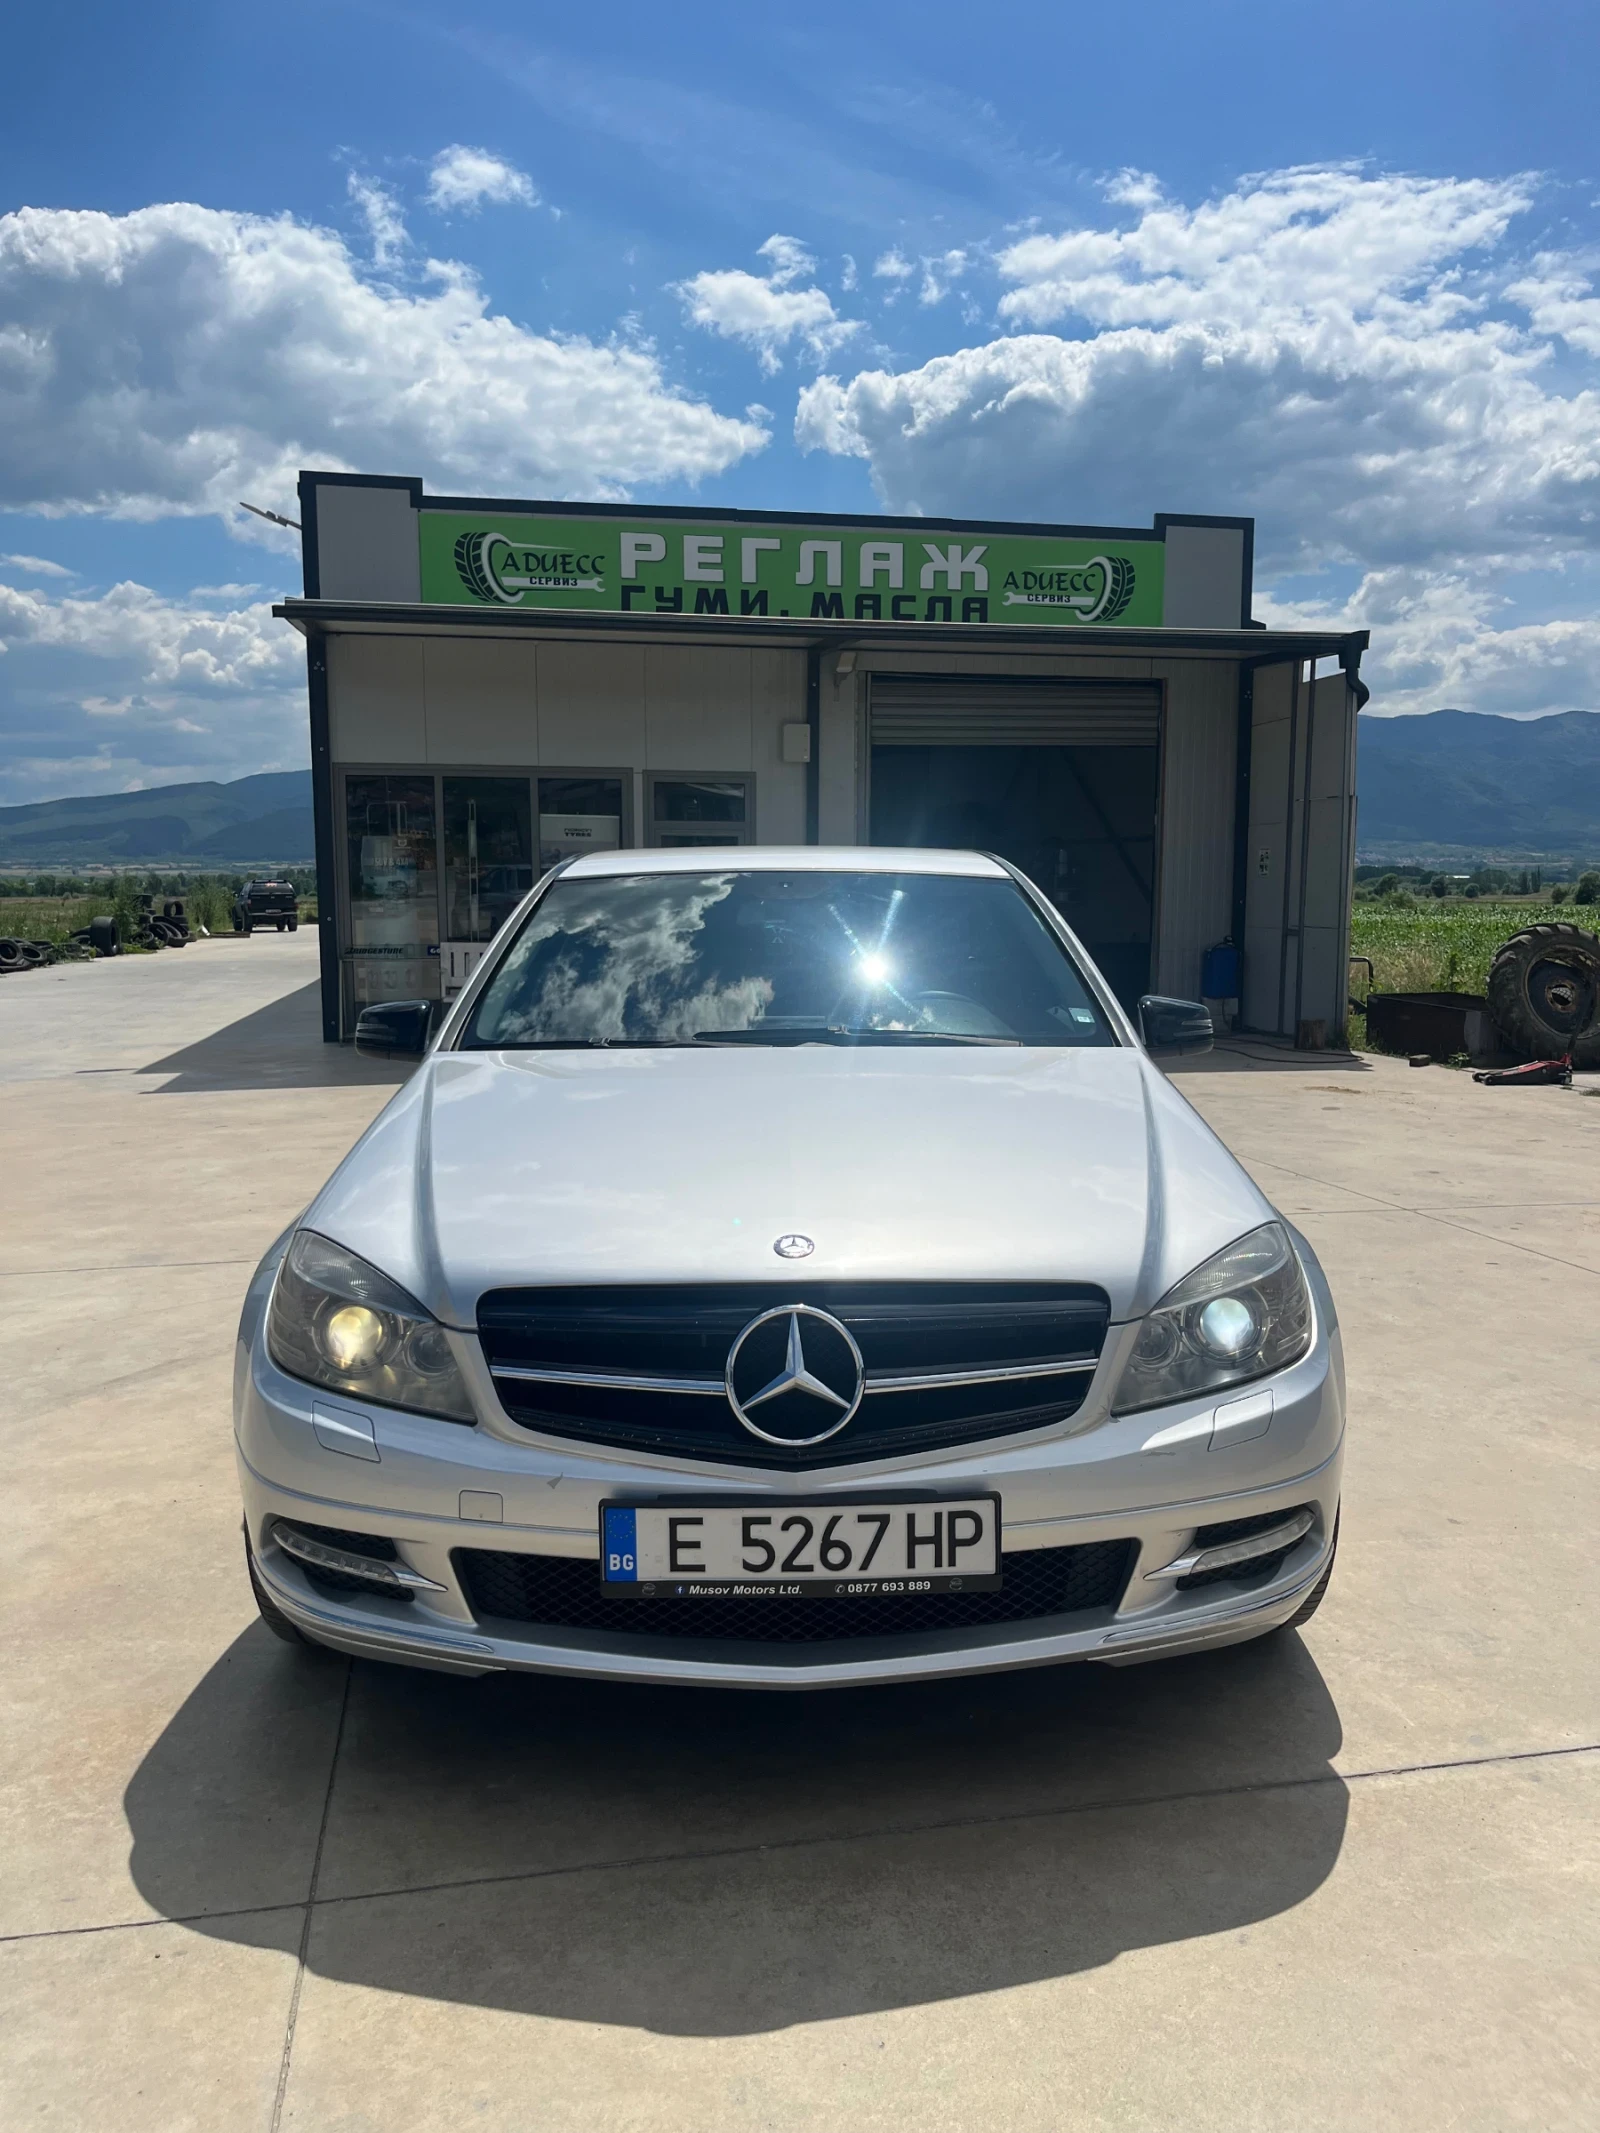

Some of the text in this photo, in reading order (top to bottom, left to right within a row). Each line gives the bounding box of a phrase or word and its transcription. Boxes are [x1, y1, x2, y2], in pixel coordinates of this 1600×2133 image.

[620, 531, 989, 591] РЕГЛАЖ
[529, 576, 578, 586] СЕРВИЗ
[1027, 593, 1071, 603] СЕРВИЗ
[810, 591, 988, 623] МАСЛА
[668, 1510, 983, 1572] E 5267 HP
[609, 1554, 634, 1570] BG
[689, 1585, 729, 1595] Musov
[733, 1585, 776, 1595] Motors
[779, 1584, 802, 1594] Ltd.
[847, 1580, 931, 1593] 0877 693 889
